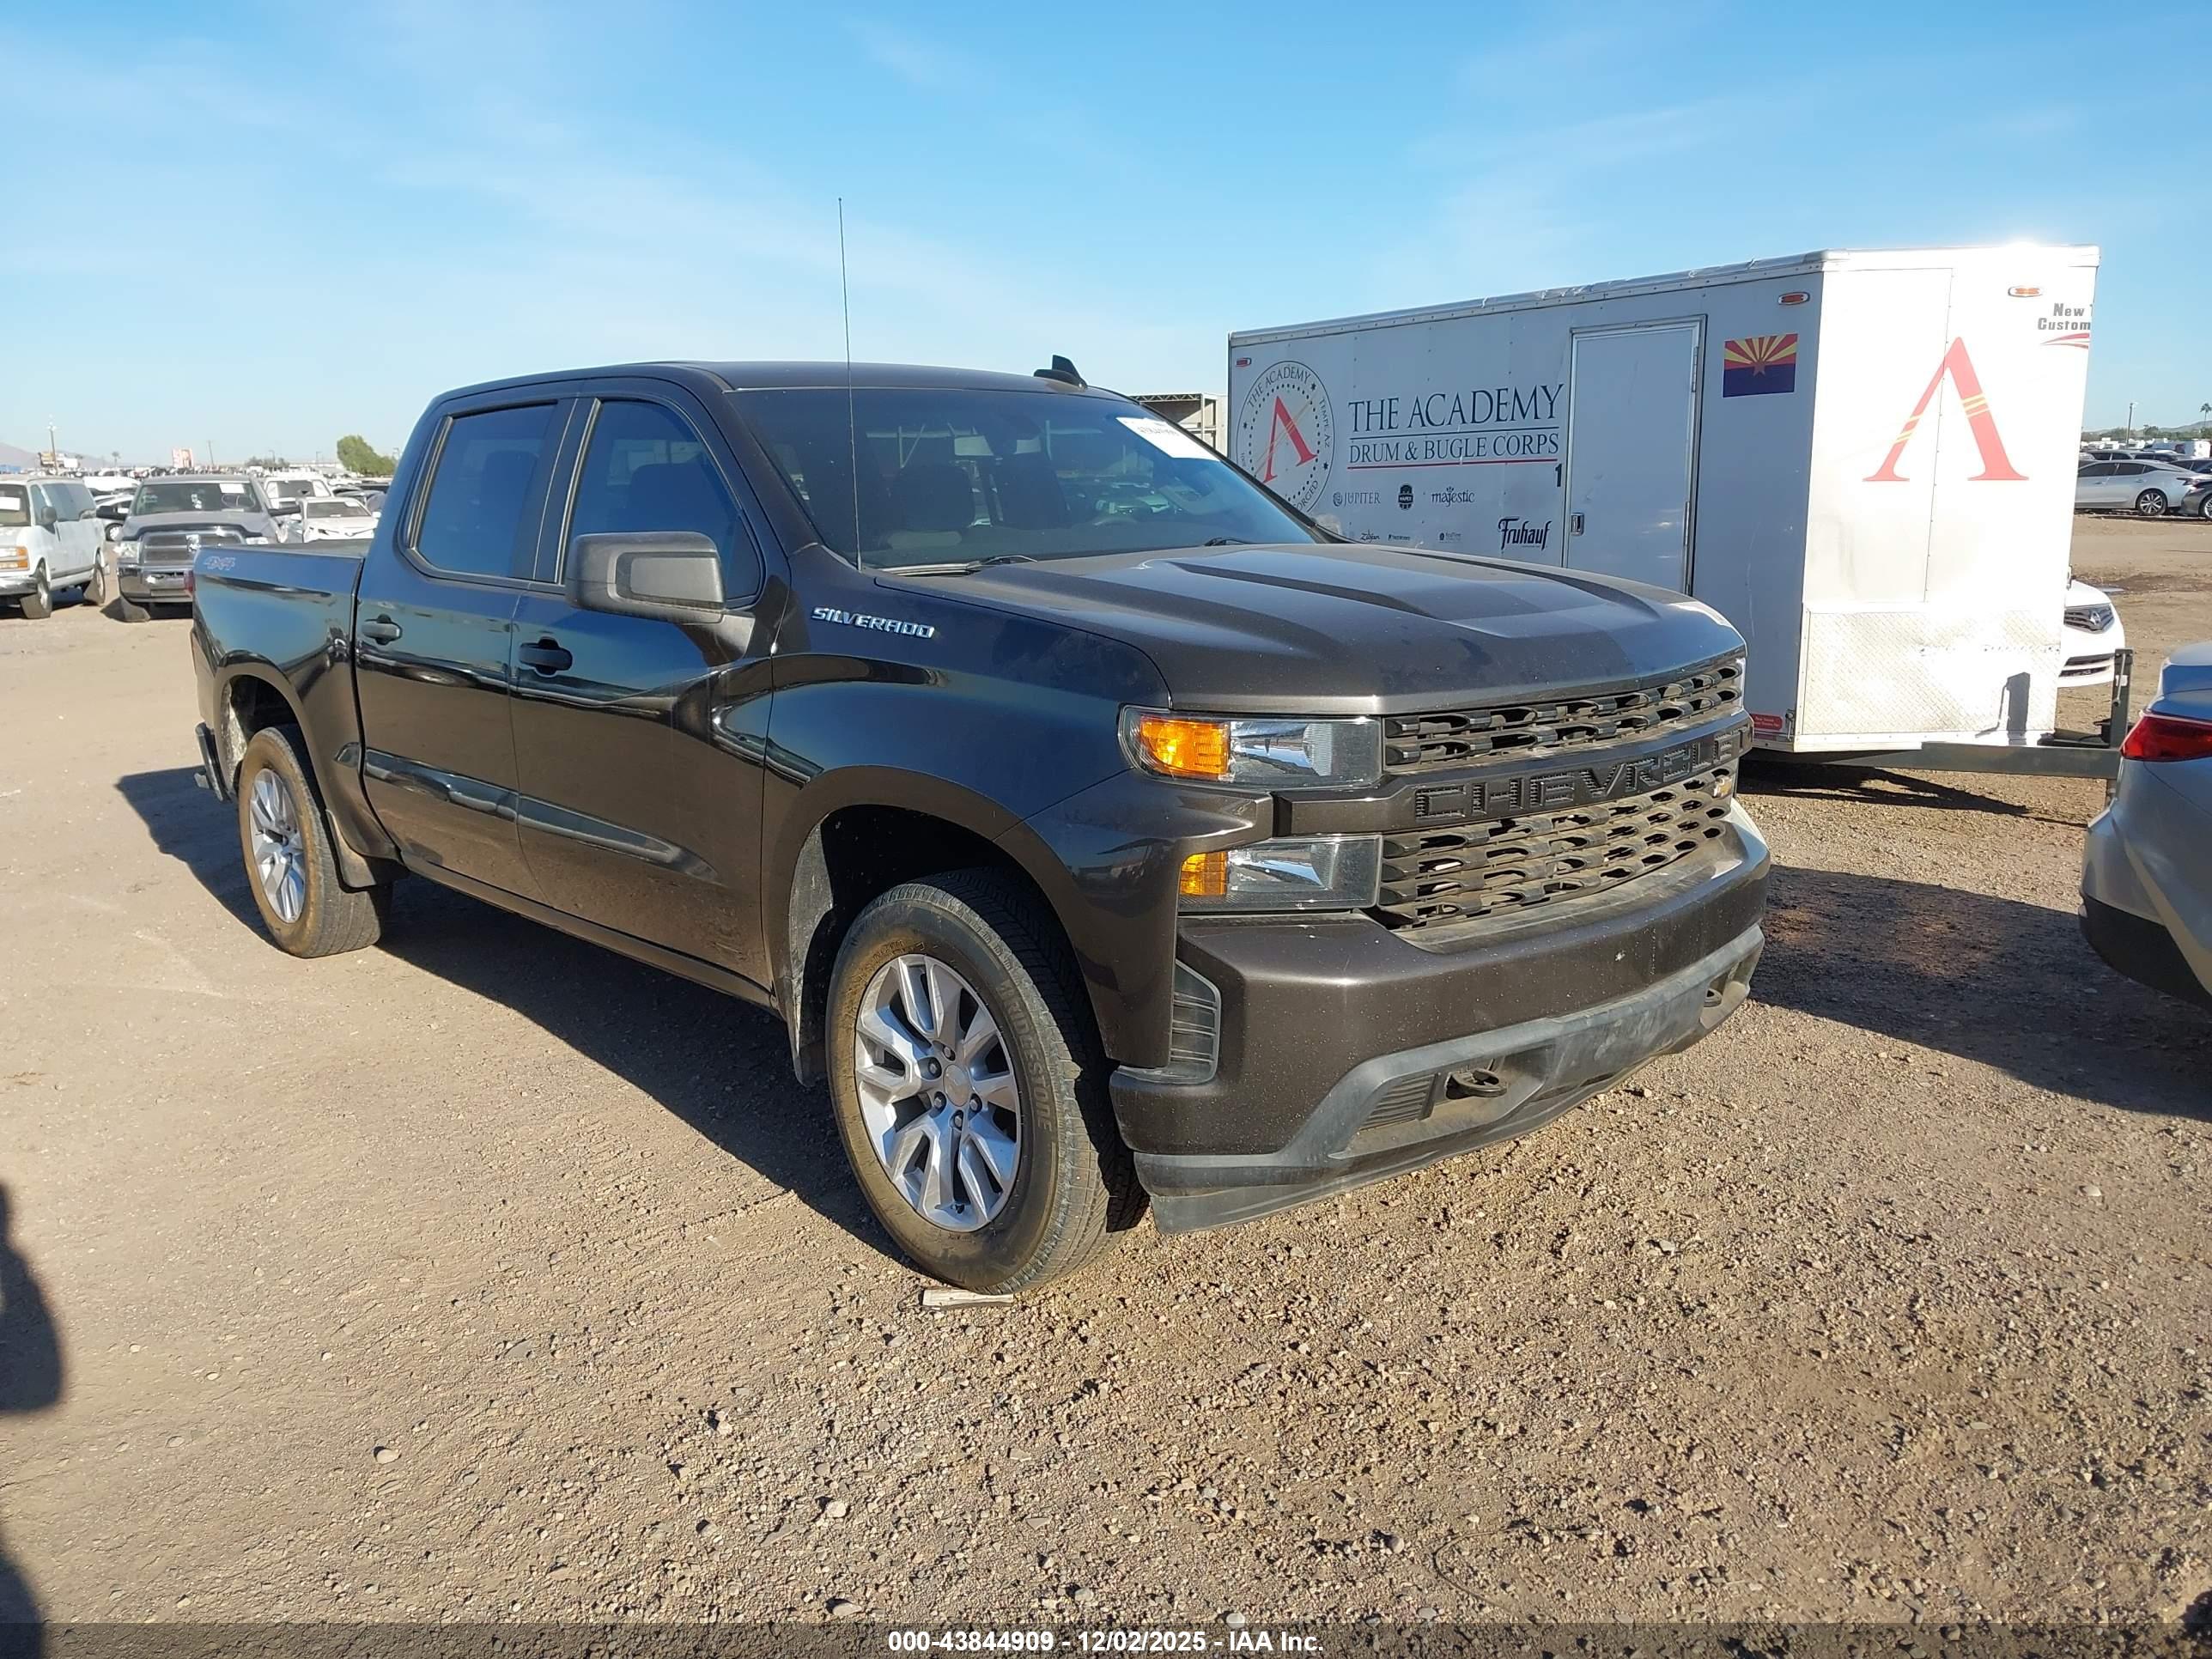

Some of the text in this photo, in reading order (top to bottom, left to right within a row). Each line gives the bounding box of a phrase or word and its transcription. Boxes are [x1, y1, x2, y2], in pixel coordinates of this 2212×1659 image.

[2038, 317, 2091, 331] Custom
[2053, 302, 2085, 317] New
[1247, 366, 1311, 408] THE ACADEMY
[1348, 383, 1565, 433] THE ACADEMY
[1349, 433, 1559, 464] DRUM & BUGLE CORPS
[1554, 463, 1563, 487] 1
[1292, 480, 1319, 511] ORGED
[1344, 492, 1381, 507] JUPITER
[1431, 487, 1476, 507] majestic
[1498, 517, 1553, 550] Fruhauf
[811, 606, 935, 639] SILVERADO
[1415, 725, 1750, 820] CHEVROLET
